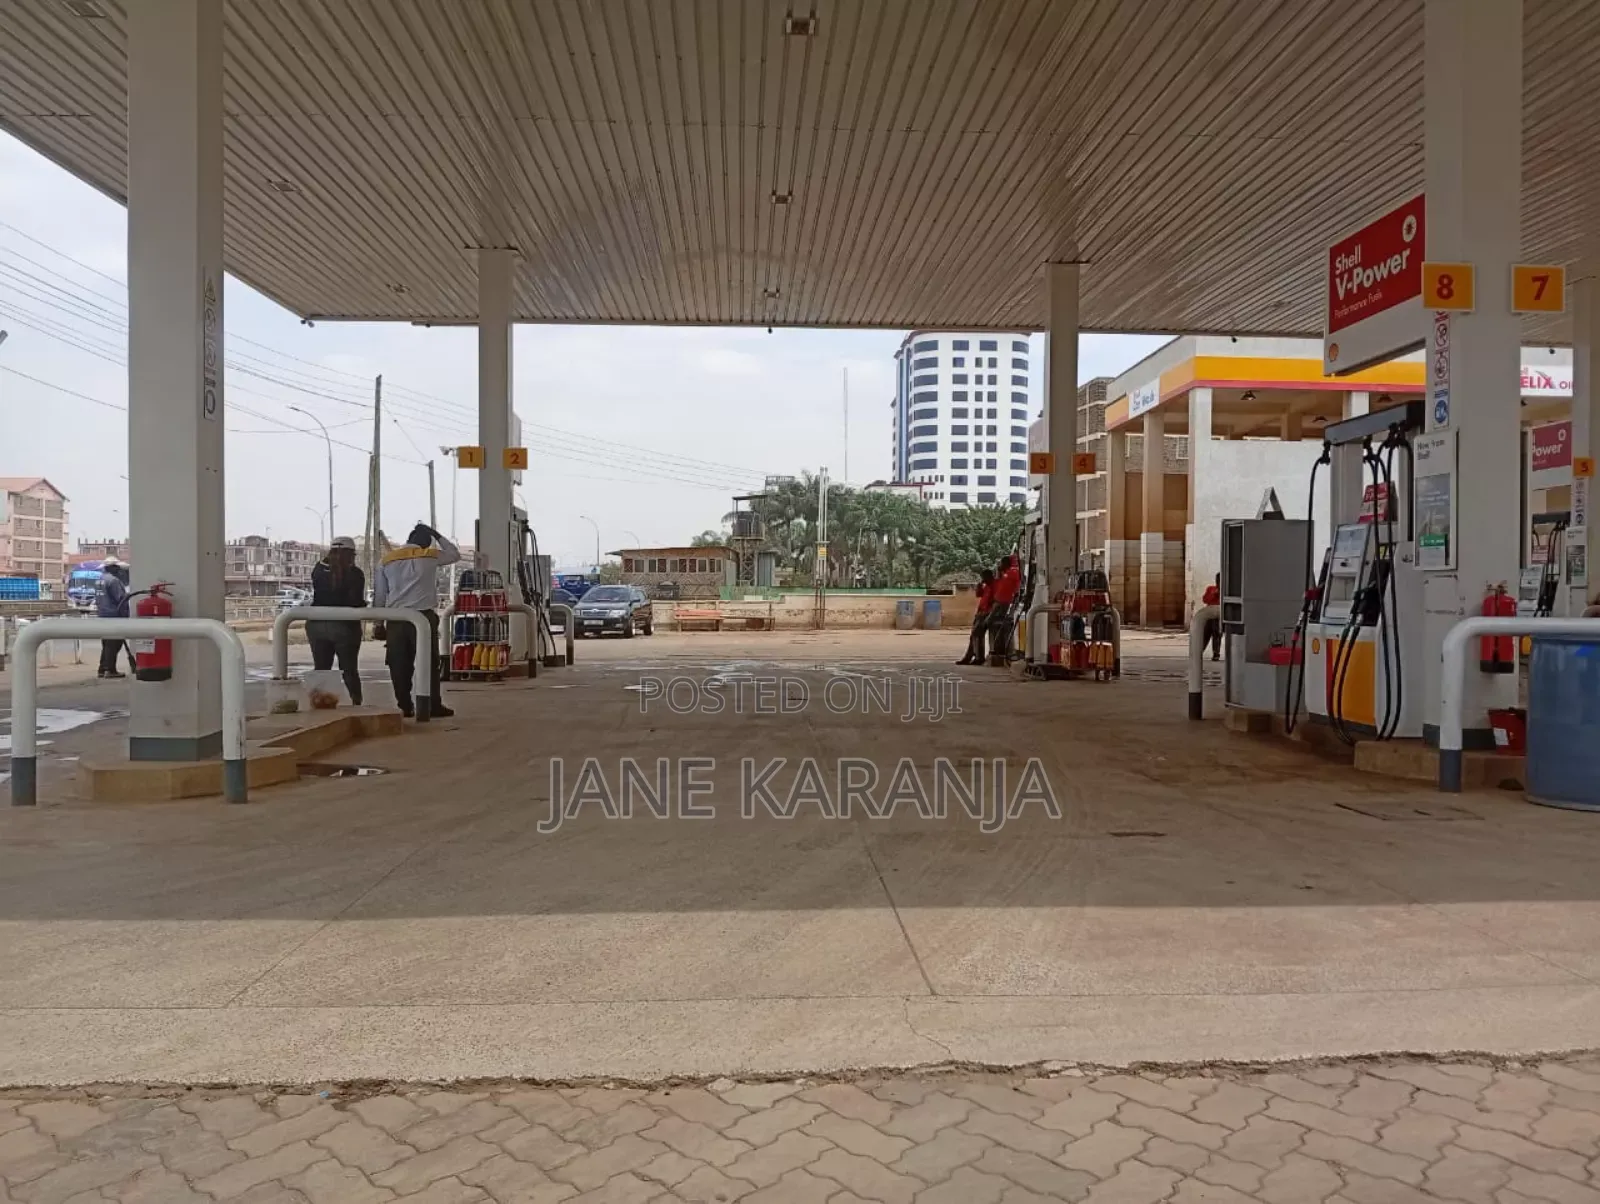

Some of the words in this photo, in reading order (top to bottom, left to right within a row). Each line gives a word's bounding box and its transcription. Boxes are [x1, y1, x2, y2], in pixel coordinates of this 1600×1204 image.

[1335, 244, 1361, 275] Shell
[1335, 248, 1411, 300] V-Power
[1436, 274, 1454, 300] 8
[1531, 274, 1549, 301] 7
[1520, 375, 1552, 389] ELIX
[467, 451, 474, 463] 1
[510, 452, 520, 465] 2
[1039, 457, 1047, 470] 3
[1078, 457, 1088, 469] 4
